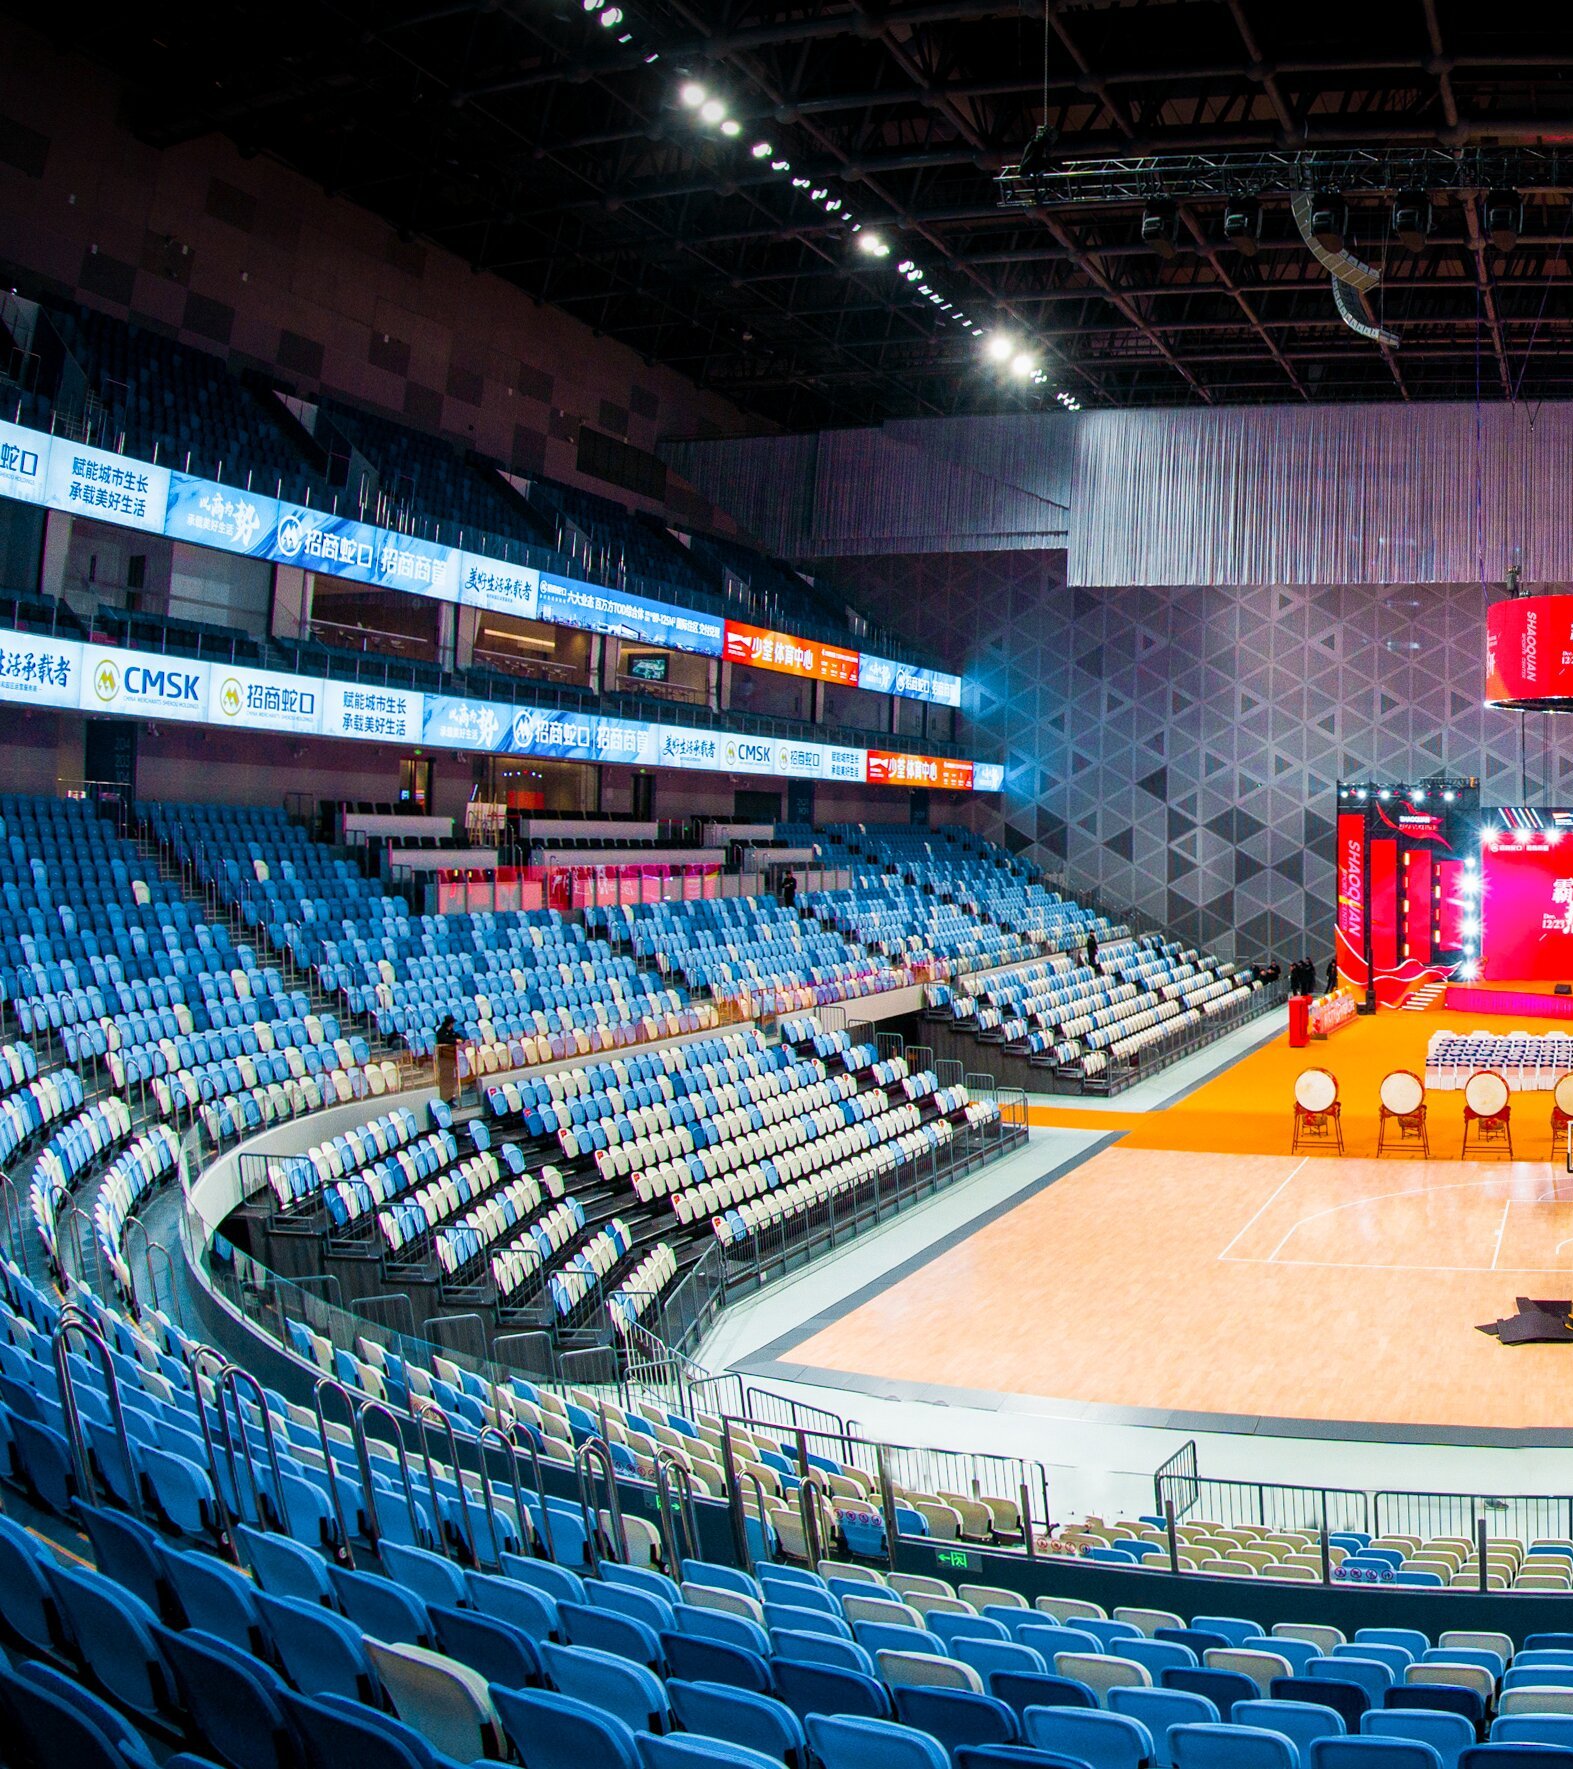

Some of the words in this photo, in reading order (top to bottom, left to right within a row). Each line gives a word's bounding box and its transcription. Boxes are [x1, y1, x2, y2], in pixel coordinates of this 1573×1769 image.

[71, 456, 149, 494] 赋能城市生长
[68, 480, 146, 518] 承载美好生活
[304, 529, 374, 569] 招商蛇口
[380, 546, 449, 586] 招商商管
[464, 565, 532, 601] 美好生活承载者
[1526, 611, 1537, 682] SHAOQUAN
[124, 666, 200, 701] CMSK
[247, 684, 315, 715] 招商蛇口
[343, 690, 407, 715] 赋能城市生长
[342, 713, 406, 736] 承载美好生活
[534, 720, 590, 748] 招商蛇口
[596, 726, 649, 753] 招商商管
[738, 744, 771, 762] CMSK
[790, 750, 820, 767] 招商蛇口
[1348, 840, 1361, 937] SHAOQUAN
